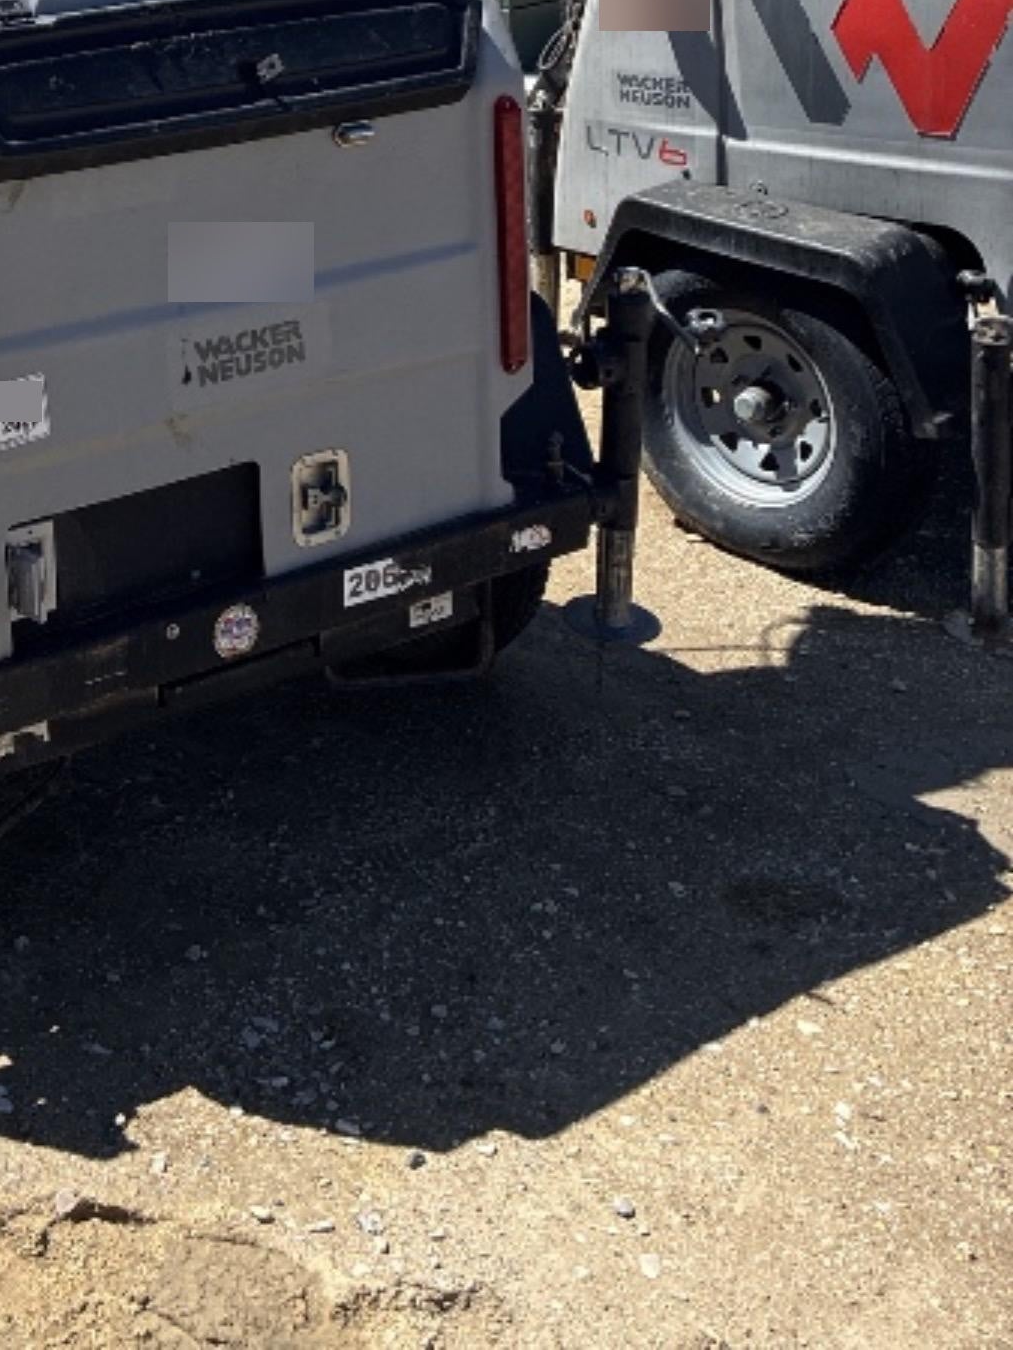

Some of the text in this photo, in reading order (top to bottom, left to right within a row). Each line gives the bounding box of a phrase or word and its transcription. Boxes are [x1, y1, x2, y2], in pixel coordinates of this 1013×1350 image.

[616, 72, 689, 94] WACKER
[619, 88, 690, 109] NEUSON
[586, 125, 688, 166] LTV6
[193, 319, 303, 363] WACKER
[196, 340, 306, 388] NEUSON
